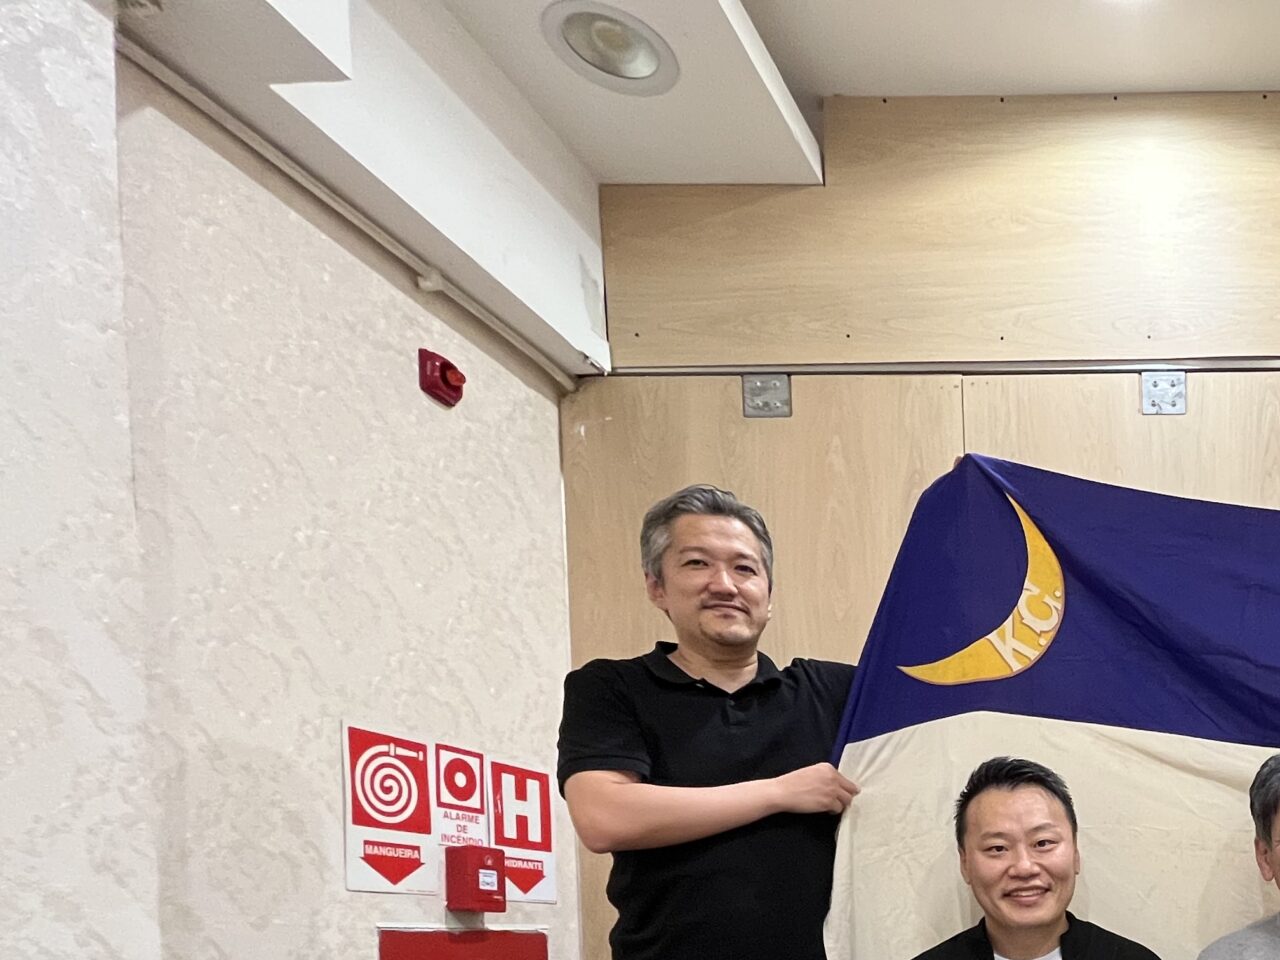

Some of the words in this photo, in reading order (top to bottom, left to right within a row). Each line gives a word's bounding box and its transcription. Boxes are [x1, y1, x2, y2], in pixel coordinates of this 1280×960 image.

[501, 772, 542, 843] H
[443, 811, 480, 824] ALARME
[456, 824, 468, 834] DE
[365, 844, 420, 859] MANGUEIRA
[505, 859, 543, 871] HIDRANTE
